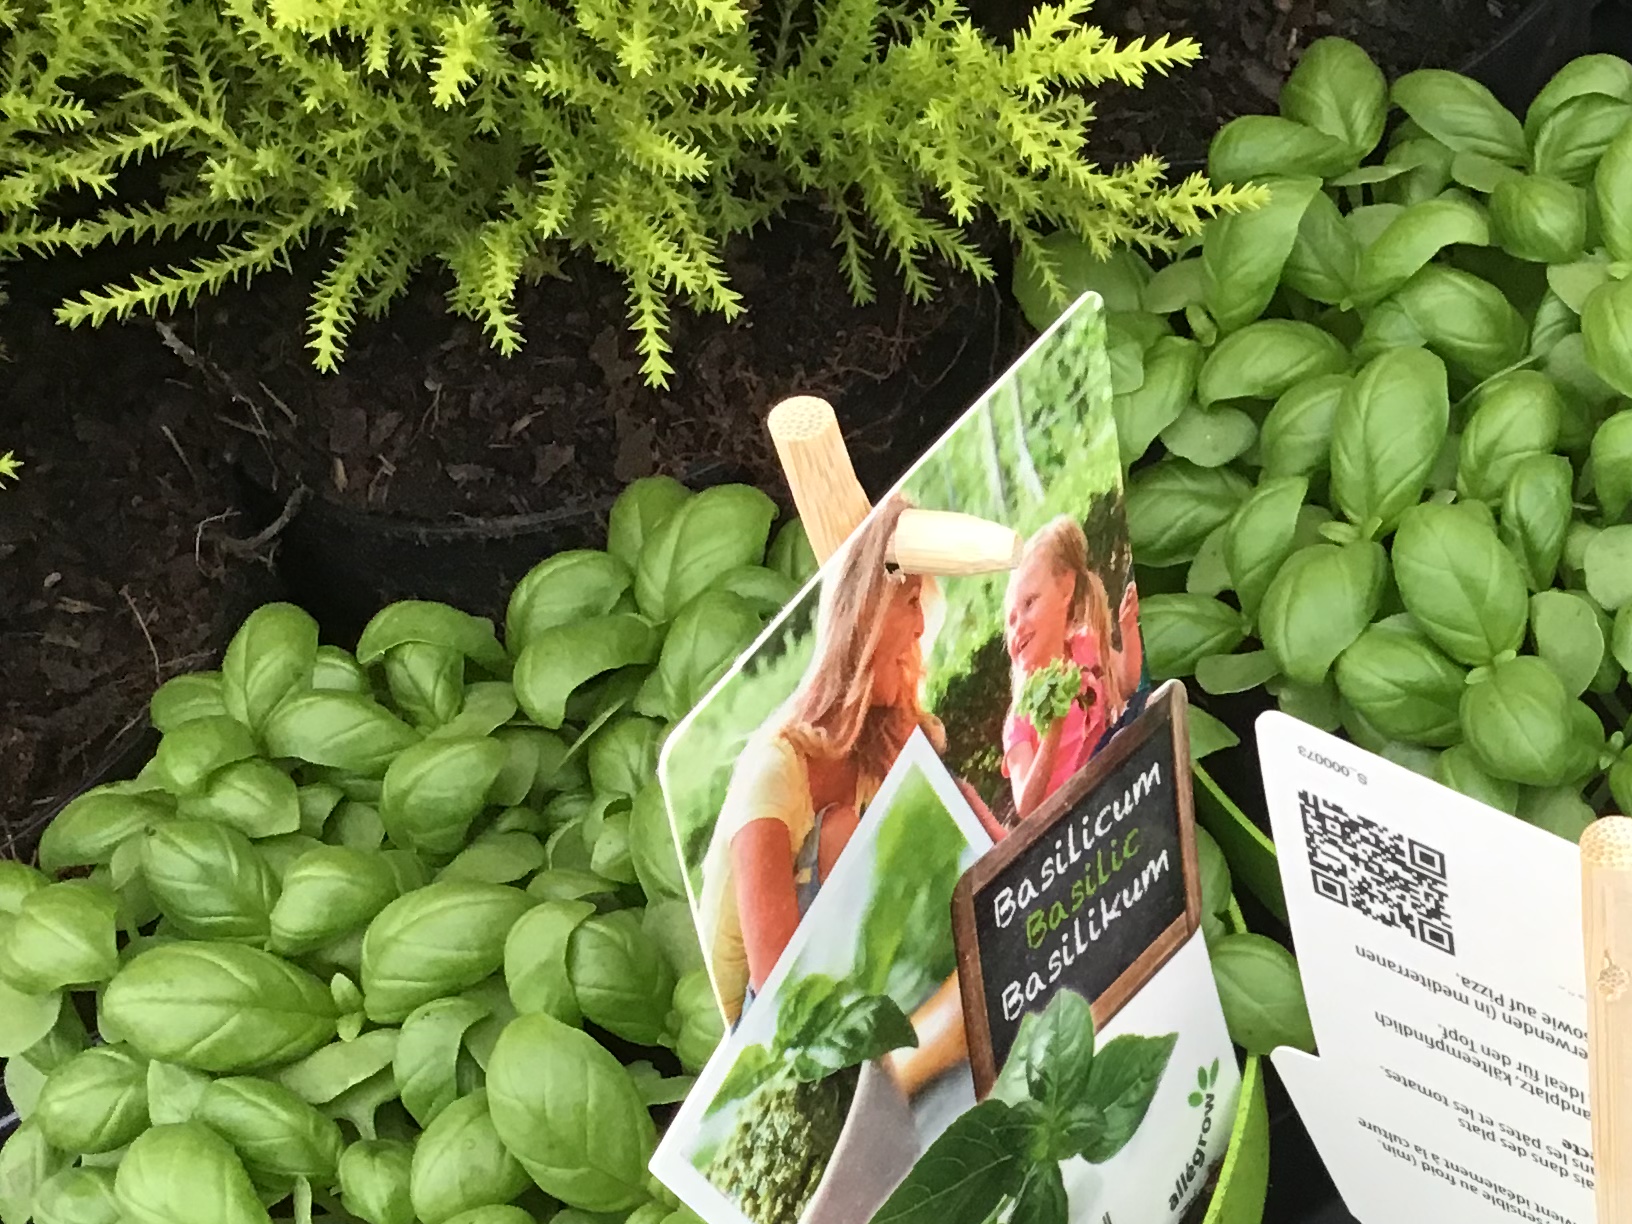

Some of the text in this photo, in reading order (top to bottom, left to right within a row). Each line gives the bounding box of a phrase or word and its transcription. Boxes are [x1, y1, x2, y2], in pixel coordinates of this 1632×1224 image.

[1297, 745, 1367, 784] S_000073
[993, 761, 1162, 929] Basilicum
[1026, 827, 1141, 949] Basilic
[1001, 849, 1170, 1022] Basilikum
[1355, 945, 1469, 1004] mediterranen
[1456, 972, 1504, 1006] Pizza.
[1474, 999, 1496, 1020] (in
[1509, 998, 1536, 1018] auf
[1375, 1011, 1511, 1086] kälteempfindlich
[1438, 1024, 1477, 1053] Topf.
[1502, 1012, 1587, 1059] erwenden
[1480, 1044, 1511, 1066] den
[1516, 1061, 1539, 1081] für
[1380, 1066, 1448, 1106] tomates.
[1515, 1075, 1590, 1119] andplatz,
[1544, 1074, 1584, 1103] Ideal
[1452, 1100, 1474, 1120] les
[1478, 1112, 1494, 1131] et
[1358, 1117, 1409, 1147] culture
[1457, 1117, 1495, 1141] plats
[1498, 1122, 1541, 1149] pâtes
[1168, 1093, 1215, 1212] allégrow
[1413, 1144, 1427, 1159] la
[1430, 1153, 1439, 1164] à
[1499, 1138, 1526, 1157] des
[1545, 1145, 1567, 1164] les
[1421, 1160, 1456, 1185] froid
[1531, 1152, 1568, 1177] dans
[1443, 1158, 1529, 1209] idéalement
[1459, 1179, 1477, 1194] au
[1573, 1173, 1594, 1189] ais
[1482, 1190, 1542, 1224] sensible
